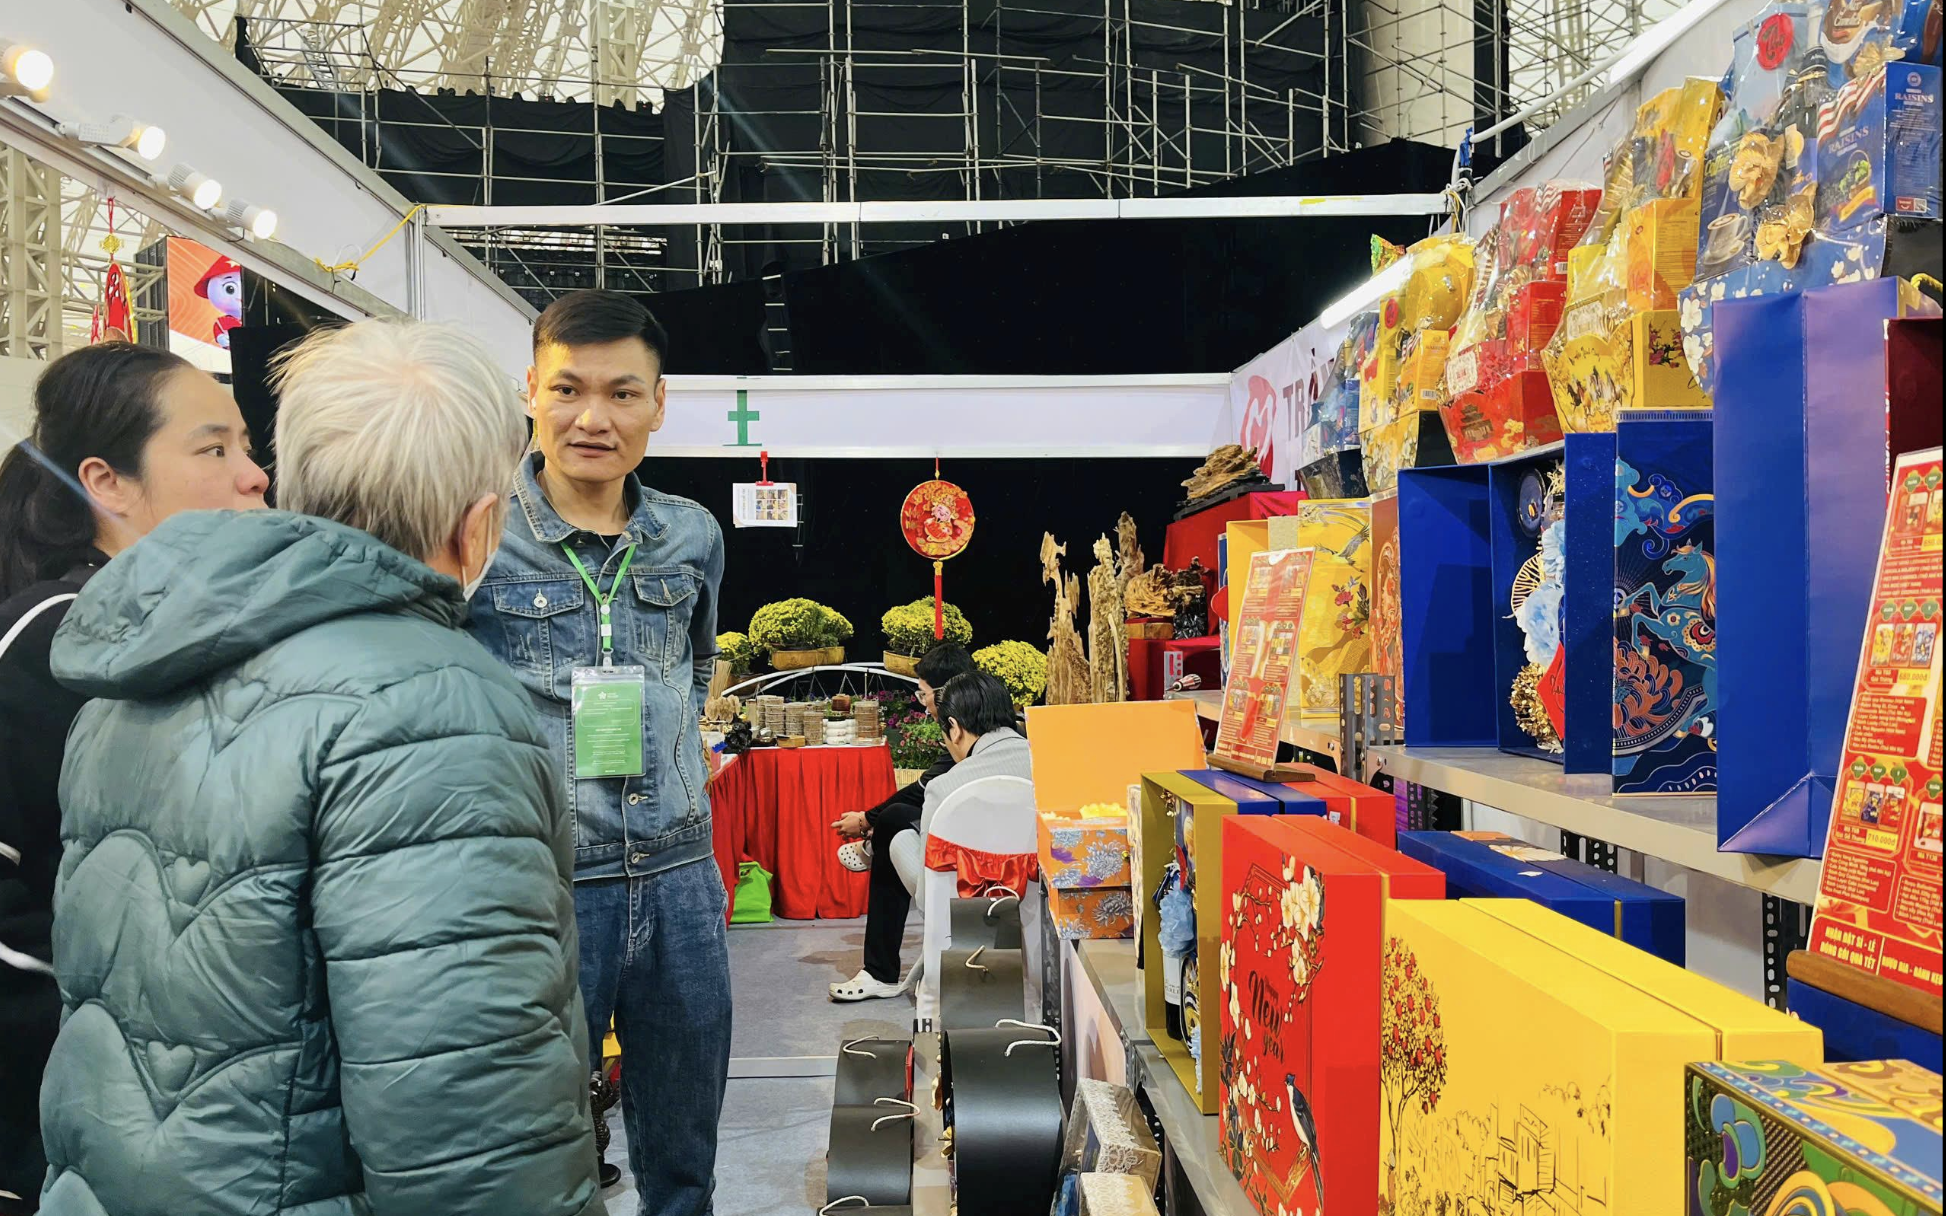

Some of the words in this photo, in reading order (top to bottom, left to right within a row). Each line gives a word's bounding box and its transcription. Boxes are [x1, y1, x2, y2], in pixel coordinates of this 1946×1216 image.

[1895, 93, 1934, 103] RAISINS
[1828, 126, 1869, 154] RAISINS
[1249, 970, 1283, 1038] New
